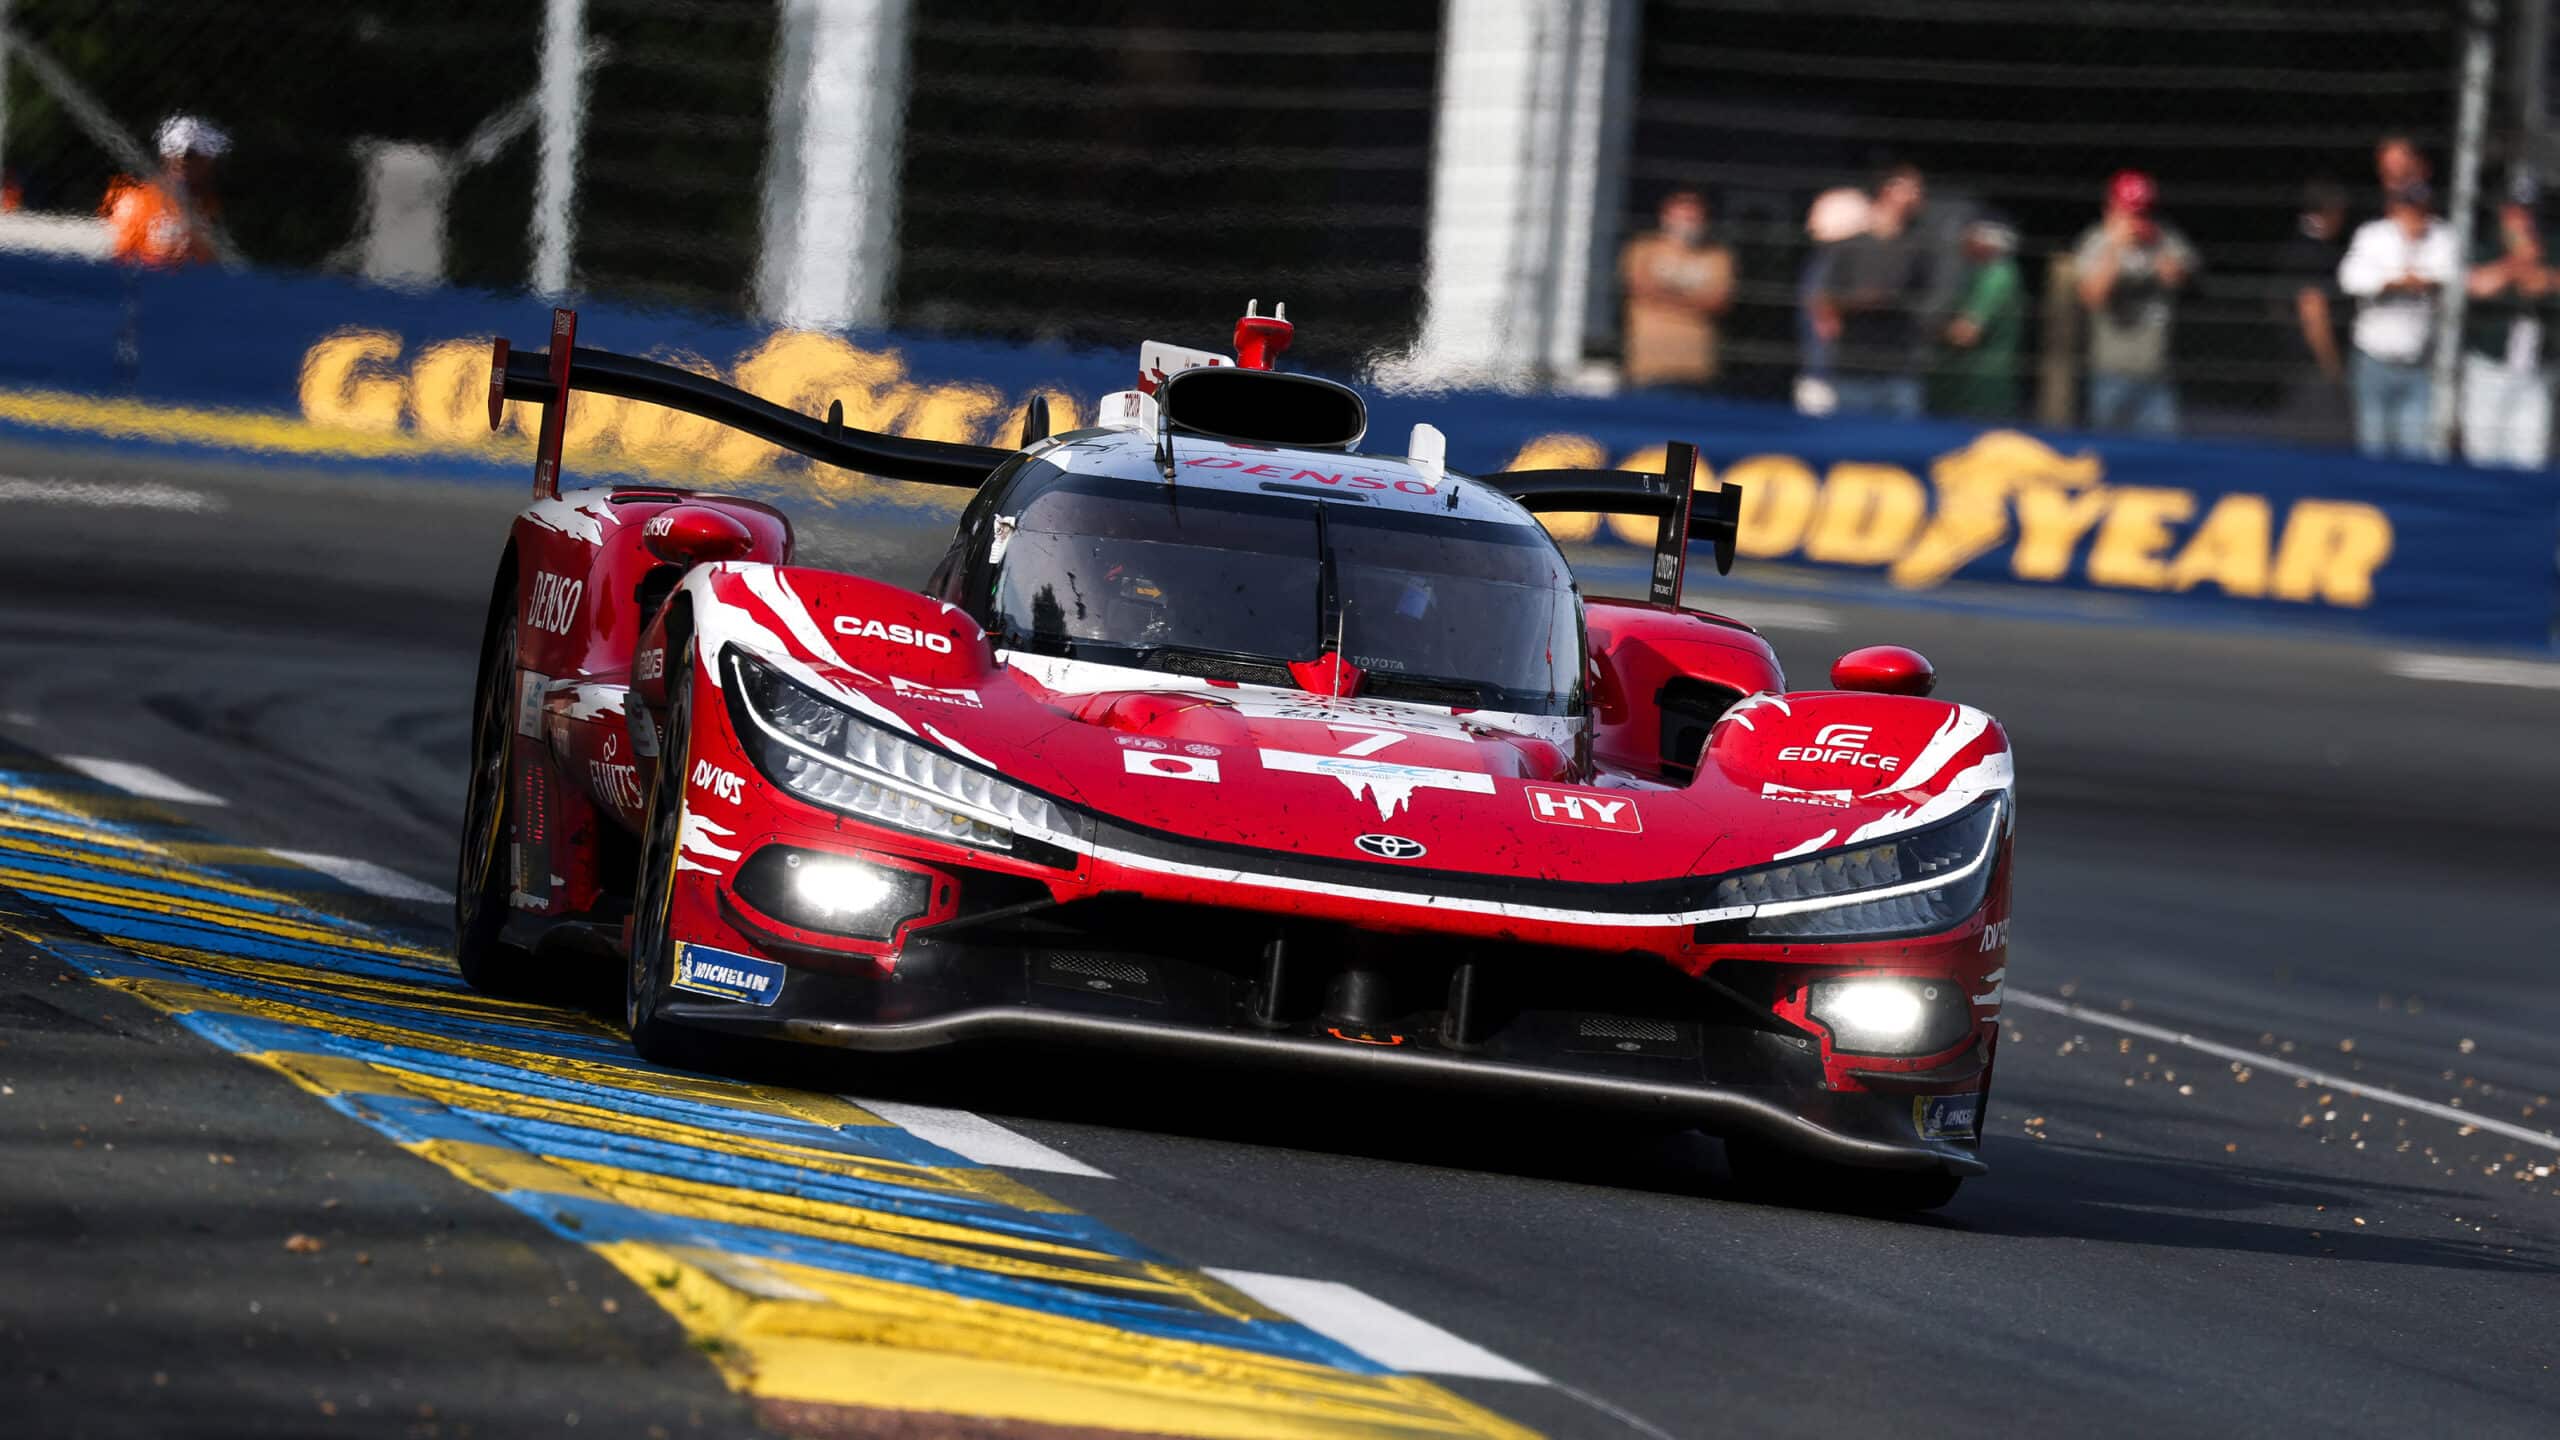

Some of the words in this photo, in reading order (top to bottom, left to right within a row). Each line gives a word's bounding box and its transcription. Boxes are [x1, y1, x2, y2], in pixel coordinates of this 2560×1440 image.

[1182, 457, 1438, 496] DENSO
[527, 570, 583, 635] DENSO
[833, 615, 952, 653] CASIO
[1353, 655, 1405, 671] TOYOTA
[895, 690, 984, 709] MARELLI
[1326, 723, 1408, 757] 7
[1777, 746, 1900, 772] EDIFICE
[1534, 792, 1626, 824] HY
[693, 961, 770, 992] MICHELIN
